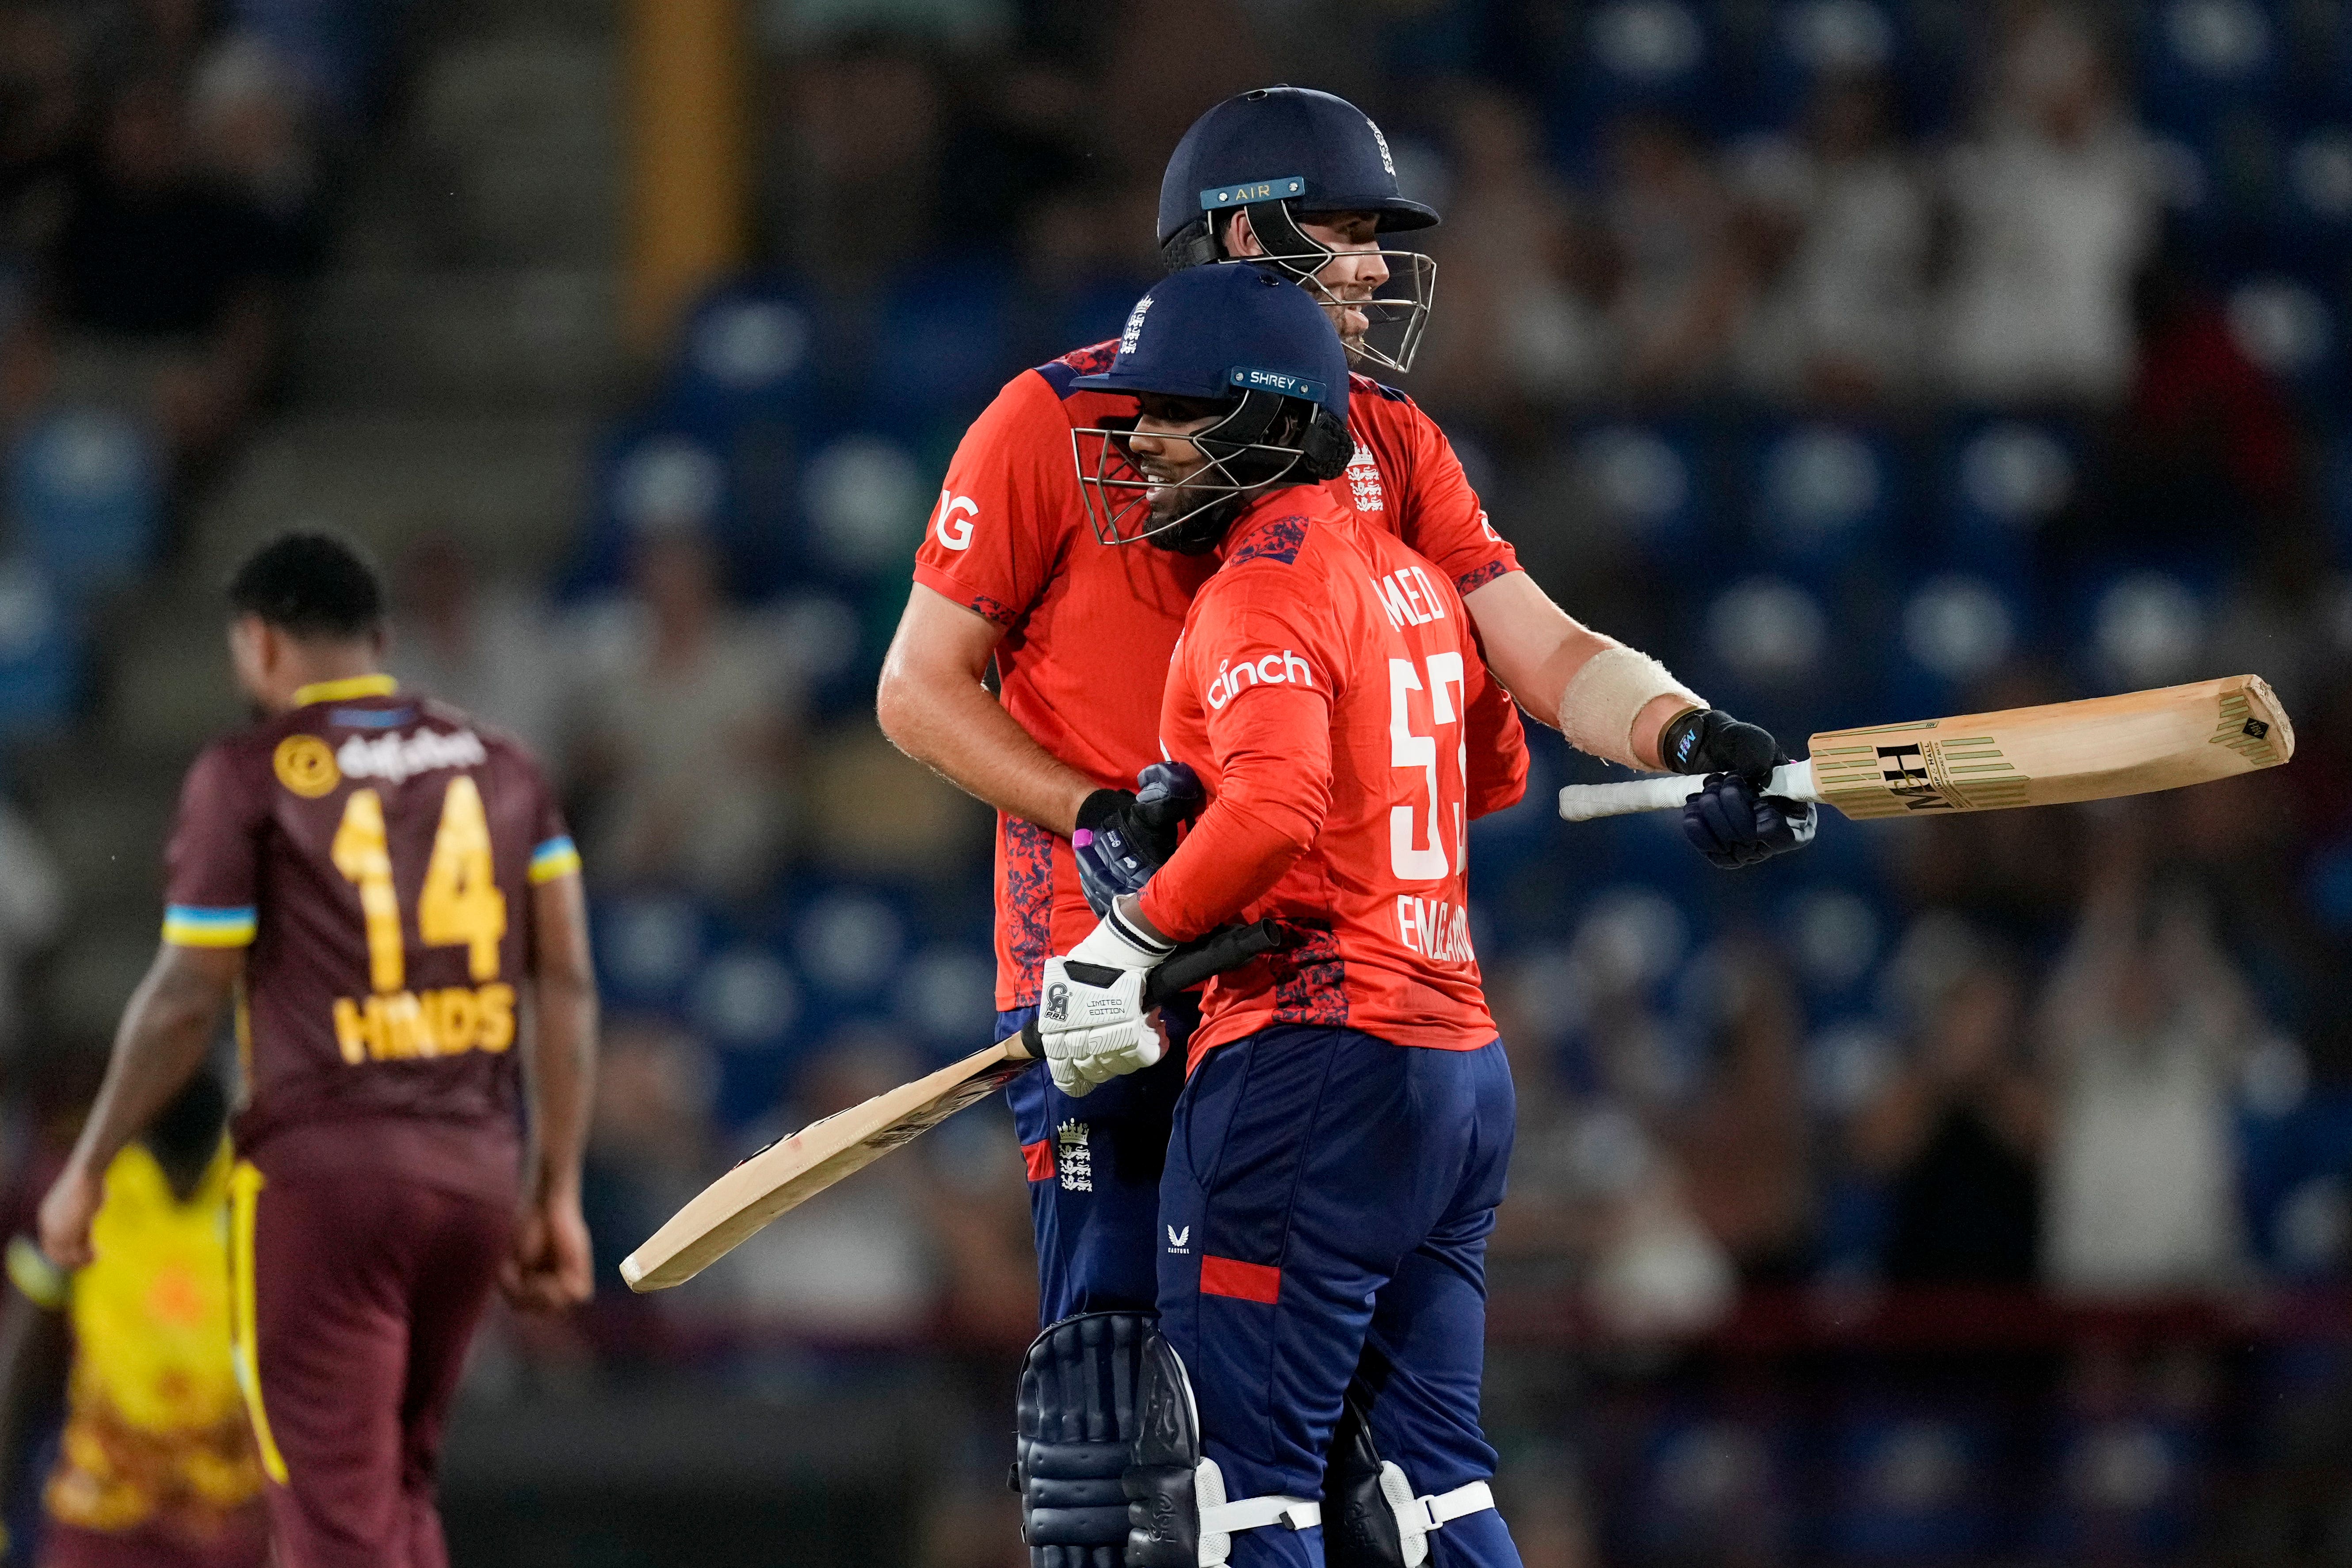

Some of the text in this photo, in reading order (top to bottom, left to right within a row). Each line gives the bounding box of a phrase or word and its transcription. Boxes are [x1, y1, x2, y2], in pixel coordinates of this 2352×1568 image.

[1235, 185, 1270, 201] AIR
[1250, 372, 1295, 389] SHREY
[935, 489, 979, 551] IG
[1369, 566, 1445, 633] MED
[1208, 650, 1313, 710] cinch
[1924, 743, 1935, 765] HALL
[1939, 757, 1948, 778] CRICKET
[330, 775, 508, 994] 14
[332, 982, 516, 1065] HINDS
[1044, 1011, 1068, 1022] PRO
